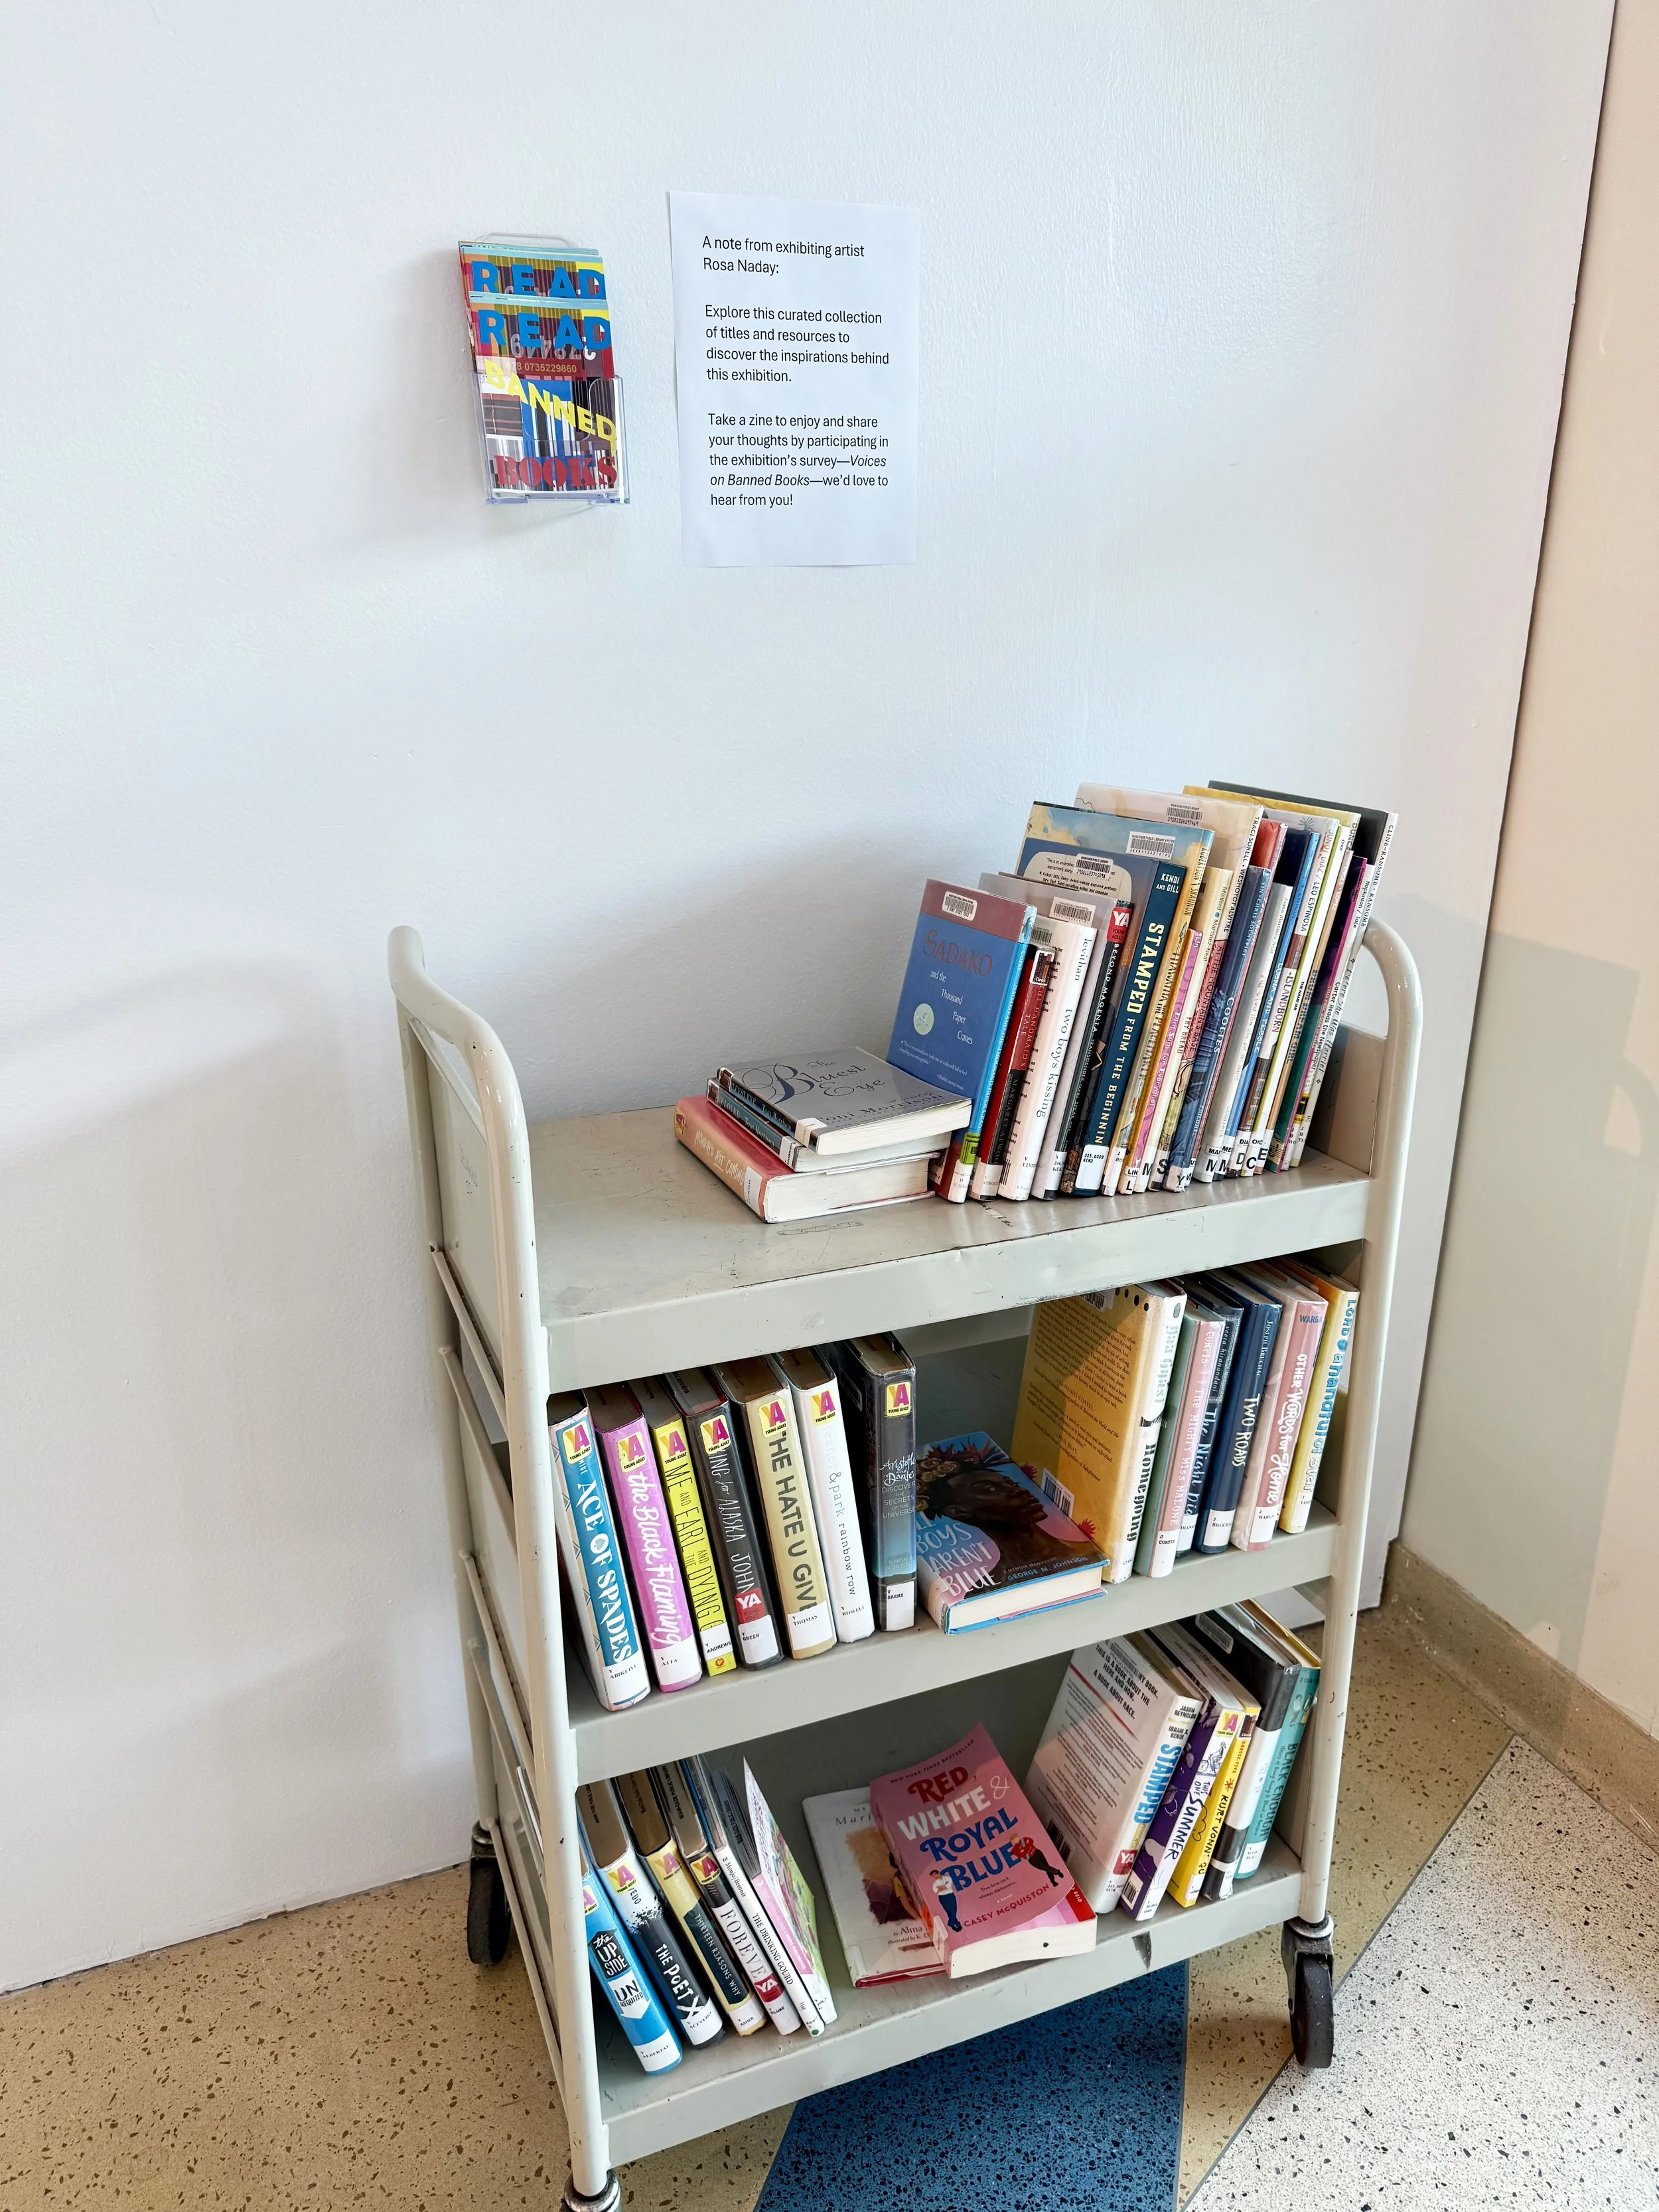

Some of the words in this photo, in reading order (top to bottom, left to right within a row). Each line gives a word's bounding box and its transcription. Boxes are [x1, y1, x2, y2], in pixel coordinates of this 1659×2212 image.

[703, 236, 711, 248] A
[715, 238, 741, 250] note
[745, 238, 772, 252] from
[776, 242, 831, 258] exhibiting
[835, 244, 864, 257] artist
[470, 261, 605, 299] READ
[703, 258, 733, 271] Rosa
[738, 259, 778, 276] Naday:
[478, 309, 612, 350] READ
[705, 305, 750, 320] Explore
[753, 307, 774, 319] this
[778, 310, 822, 321] curated
[826, 311, 881, 323] collection
[706, 326, 717, 338] of
[720, 327, 749, 339] titles
[753, 329, 774, 340] and
[778, 332, 835, 342] resources
[838, 332, 849, 342] to
[506, 362, 522, 372] 978
[524, 362, 577, 374] 0735229860
[707, 347, 757, 360] discover
[759, 348, 778, 361] the
[782, 349, 847, 364] inspirations
[851, 352, 889, 364] behind
[707, 368, 728, 380] this
[732, 369, 791, 382] exhibition.
[484, 358, 616, 451] BANNED
[708, 413, 735, 425] Take
[739, 417, 745, 425] a
[749, 414, 772, 425] zine
[775, 415, 786, 426] to
[790, 415, 820, 429] enjoy
[824, 415, 843, 427] and
[847, 416, 877, 427] share
[709, 436, 734, 448] your
[737, 434, 788, 449] thoughts
[792, 435, 804, 449] by
[808, 435, 877, 449] participating
[880, 435, 888, 447] in
[494, 455, 617, 488] BOOKS
[709, 454, 728, 465] the
[731, 454, 796, 466] exhibition’s
[800, 455, 886, 469] survey—Voices
[711, 477, 724, 485] on
[728, 474, 772, 485] Banned
[775, 475, 849, 486] Books—we’d
[853, 475, 875, 486] love
[878, 476, 888, 486] to
[711, 494, 737, 505] hear
[739, 494, 766, 505] from
[769, 494, 792, 508] you!
[1250, 817, 1260, 838] TRACI
[1244, 838, 1253, 863] SORELL
[1161, 873, 1180, 883] KENDI
[1232, 869, 1246, 907] WESHOYOT
[1311, 882, 1320, 896] LEO
[1224, 907, 1234, 932] ALVITRE
[1301, 897, 1316, 931] ESPINOSA
[923, 930, 992, 978] SADAKO
[1074, 938, 1092, 981] levithan
[1127, 922, 1165, 1013] STAMPED
[930, 970, 939, 979] and
[942, 988, 962, 1004] Thousand
[953, 1011, 966, 1024] Paper
[1060, 1009, 1074, 1033] two
[1169, 1011, 1181, 1031] Dim
[1214, 997, 1234, 1053] COOLIES
[958, 1030, 973, 1044] Cranes
[1119, 1018, 1136, 1052] FROM
[1165, 1032, 1174, 1049] Sum
[1051, 1036, 1068, 1069] boys
[1111, 1057, 1125, 1080] THE
[731, 1063, 866, 1105] Bluest
[822, 1078, 885, 1097] Eye
[1036, 1073, 1059, 1119] kissing
[1151, 1068, 1165, 1107] Everyone!
[1095, 1086, 1117, 1143] BEGINNIN
[714, 1149, 725, 1169] NOT
[726, 1159, 745, 1187] COMING
[1291, 1354, 1307, 1387] OTHER
[1278, 1388, 1301, 1436] WORDS
[1232, 1432, 1253, 1468] ROADS
[1278, 1435, 1292, 1455] for
[628, 1471, 649, 1506] the
[665, 1463, 692, 1493] ME
[715, 1479, 734, 1495] for
[1126, 1443, 1156, 1542] Homegoing
[1267, 1451, 1290, 1503] Home
[576, 1479, 605, 1532] ACE
[679, 1491, 693, 1507] AND
[776, 1475, 804, 1538] HATE
[632, 1506, 664, 1564] Black
[675, 1507, 705, 1552] EARL
[717, 1499, 746, 1542] ALASKA
[589, 1532, 614, 1566] OF
[788, 1540, 808, 1557] U
[916, 1522, 972, 1554] BOYS
[685, 1554, 697, 1570] THE
[697, 1550, 710, 1564] AND
[929, 1542, 992, 1573] AREN'T
[688, 1566, 721, 1621] DYING
[943, 1566, 1001, 1596] BLUE
[597, 1571, 634, 1663] SPADES
[646, 1561, 683, 1644] Flaming
[1096, 1645, 1106, 1657] THIS
[1114, 1663, 1126, 1680] BOOK
[1127, 1677, 1141, 1696] ABOUT
[1141, 1693, 1150, 1706] THE
[1103, 1662, 1114, 1677] HERE
[1114, 1676, 1123, 1688] AND
[1124, 1685, 1134, 1701] NOW.
[1098, 1673, 1109, 1689] BOOK
[1110, 1686, 1123, 1704] ABOUT
[1123, 1702, 1135, 1720] RACE.
[1278, 1743, 1297, 1781] BLACK
[908, 1767, 977, 1804] RED,
[1134, 1743, 1182, 1823] STAMPED
[1201, 1781, 1212, 1796] THIS
[897, 1787, 991, 1840] WHITE
[990, 1775, 1010, 1799] &
[1260, 1783, 1284, 1837] ENOUGH
[920, 1806, 1018, 1862] ROYAL
[1164, 1791, 1202, 1860] SUMMER
[941, 1842, 1021, 1892] BLUE
[964, 1912, 993, 1927] CASEY
[593, 1933, 612, 1948] the
[597, 1943, 618, 1962] UP
[656, 1944, 671, 1967] THE
[695, 1913, 715, 1949] THIRTEEN
[712, 1947, 732, 1980] R3ASONS
[729, 1979, 741, 1996] WHY
[753, 1912, 763, 1931] THE
[760, 1926, 781, 1964] DRINKING
[777, 1959, 794, 1986] GOURD
[605, 1956, 628, 1976] SIDE
[663, 1963, 693, 2001] POET
[614, 1980, 638, 2001] UN
[619, 1992, 644, 2008] REQUITED
[676, 1994, 705, 2021] X
